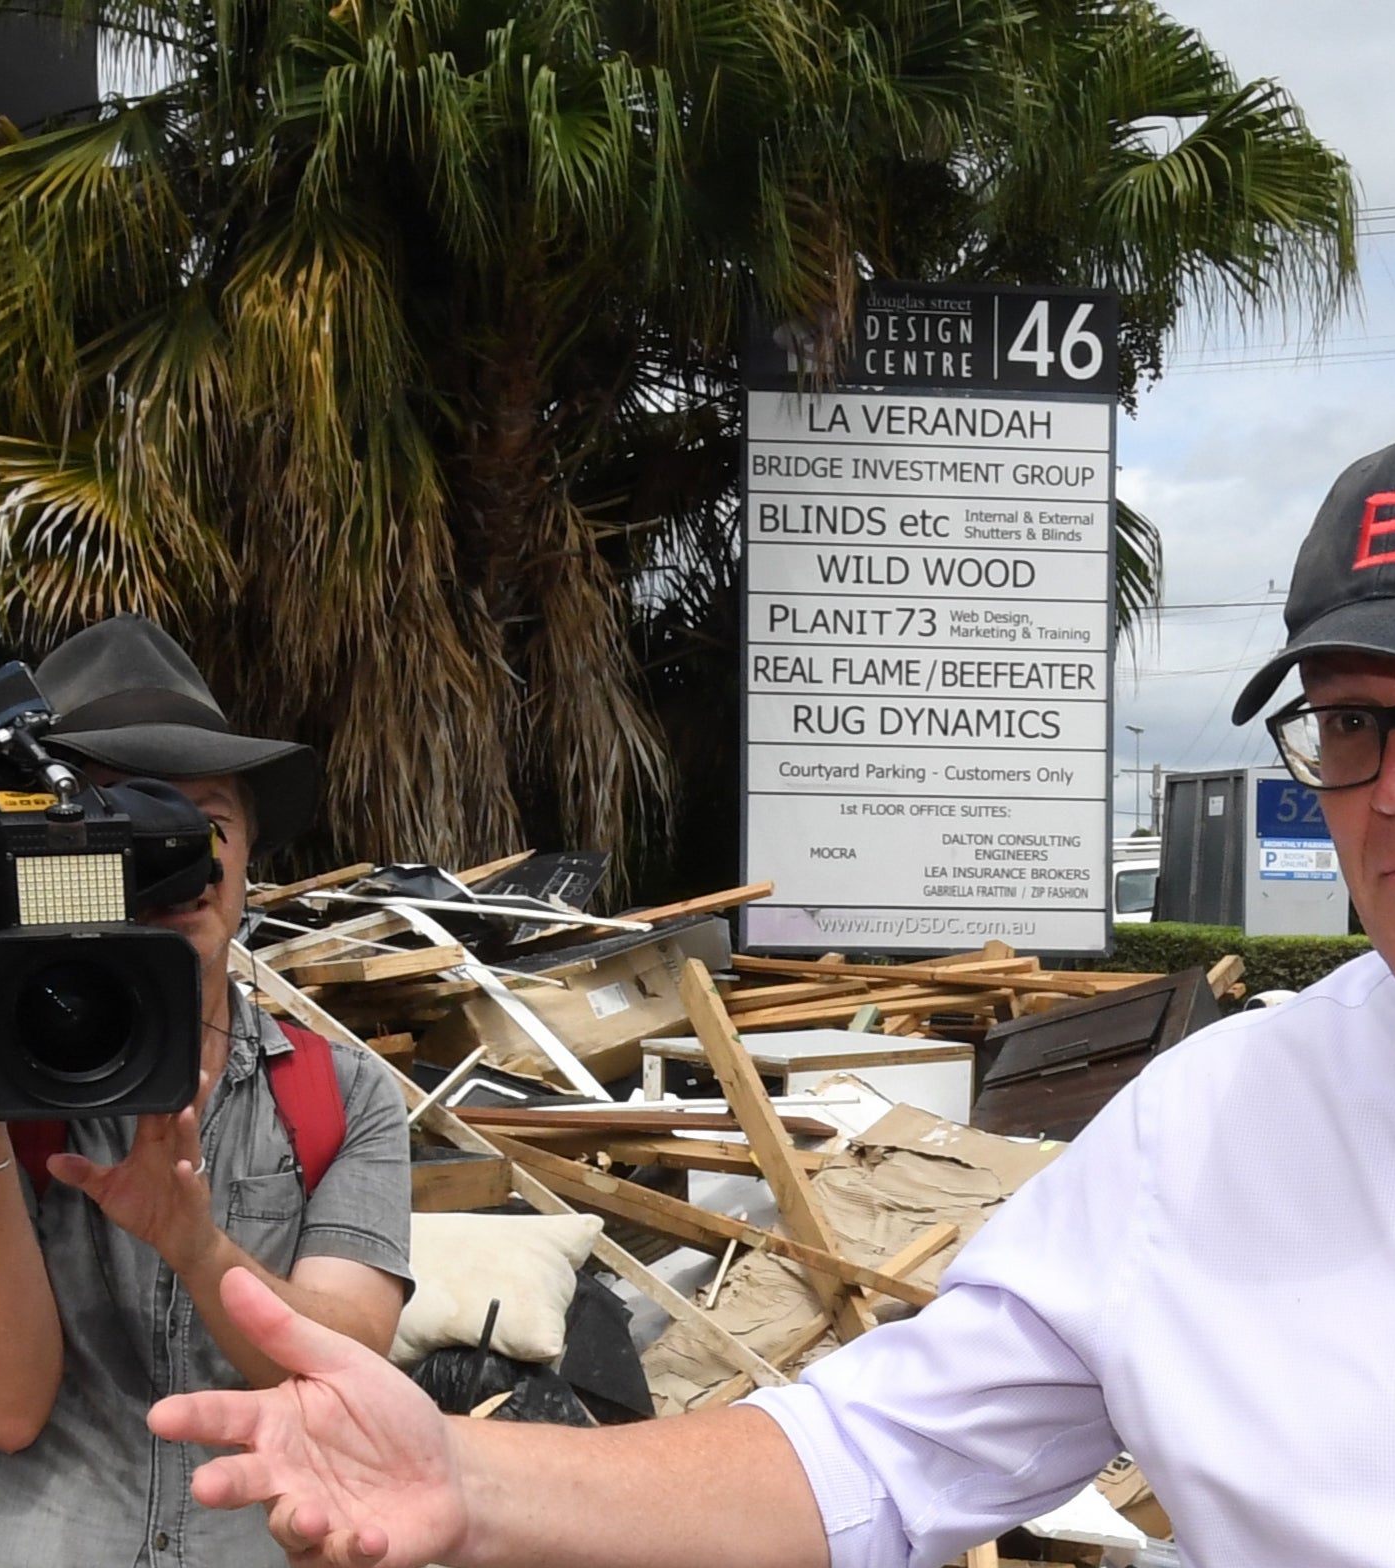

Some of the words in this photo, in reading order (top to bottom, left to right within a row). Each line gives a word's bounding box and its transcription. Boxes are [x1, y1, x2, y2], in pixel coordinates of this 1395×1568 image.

[867, 315, 972, 344] DESIGN
[1007, 300, 1103, 380] 46
[866, 349, 972, 378] CENTRE
[809, 400, 850, 433] LA
[861, 405, 1050, 439] VERANDAH
[753, 455, 842, 478] BRIDGE
[852, 458, 1004, 483] INVESTMENT
[1013, 464, 1094, 486] GROUP
[760, 504, 886, 535] BLINDS
[900, 510, 949, 537] etc
[965, 509, 1018, 523] Internal
[1023, 511, 1033, 523] &
[1039, 512, 1093, 525] External
[965, 526, 1021, 540] Shutters
[1026, 528, 1036, 540] &
[1042, 528, 1082, 541] Blinds
[817, 554, 909, 584] WILD
[923, 558, 1035, 588] WOOD
[950, 610, 979, 622] Web
[984, 611, 1033, 627] Design,
[950, 625, 1016, 641] Marketing
[1022, 627, 1031, 639] &
[1037, 627, 1090, 643] Training
[754, 656, 822, 683] REAL
[794, 705, 864, 734] RUG
[880, 707, 1060, 739] DYNAMICS
[779, 762, 859, 781] Courtyard
[866, 764, 925, 783] Parking
[945, 766, 1031, 781] Customers
[1037, 768, 1073, 786] Only
[841, 804, 857, 815] 1st
[862, 804, 905, 815] FLOOR
[910, 805, 955, 816] OFFICE
[961, 805, 1011, 817] SUITES:
[942, 834, 993, 845] DALTON
[998, 834, 1081, 847] CONSULTING
[810, 847, 856, 859] MOCRA
[975, 849, 1048, 861] ENGINEERS
[925, 867, 947, 878] LEA
[953, 867, 1026, 879] INSURANCE
[1031, 868, 1090, 880] BROKERS
[923, 885, 974, 897] GABRIELLA
[977, 886, 1016, 897] FRATTINI
[1031, 886, 1045, 898] ZIP
[1048, 887, 1088, 899] FASHION
[818, 918, 1036, 936] www.myDSDC.com.au
